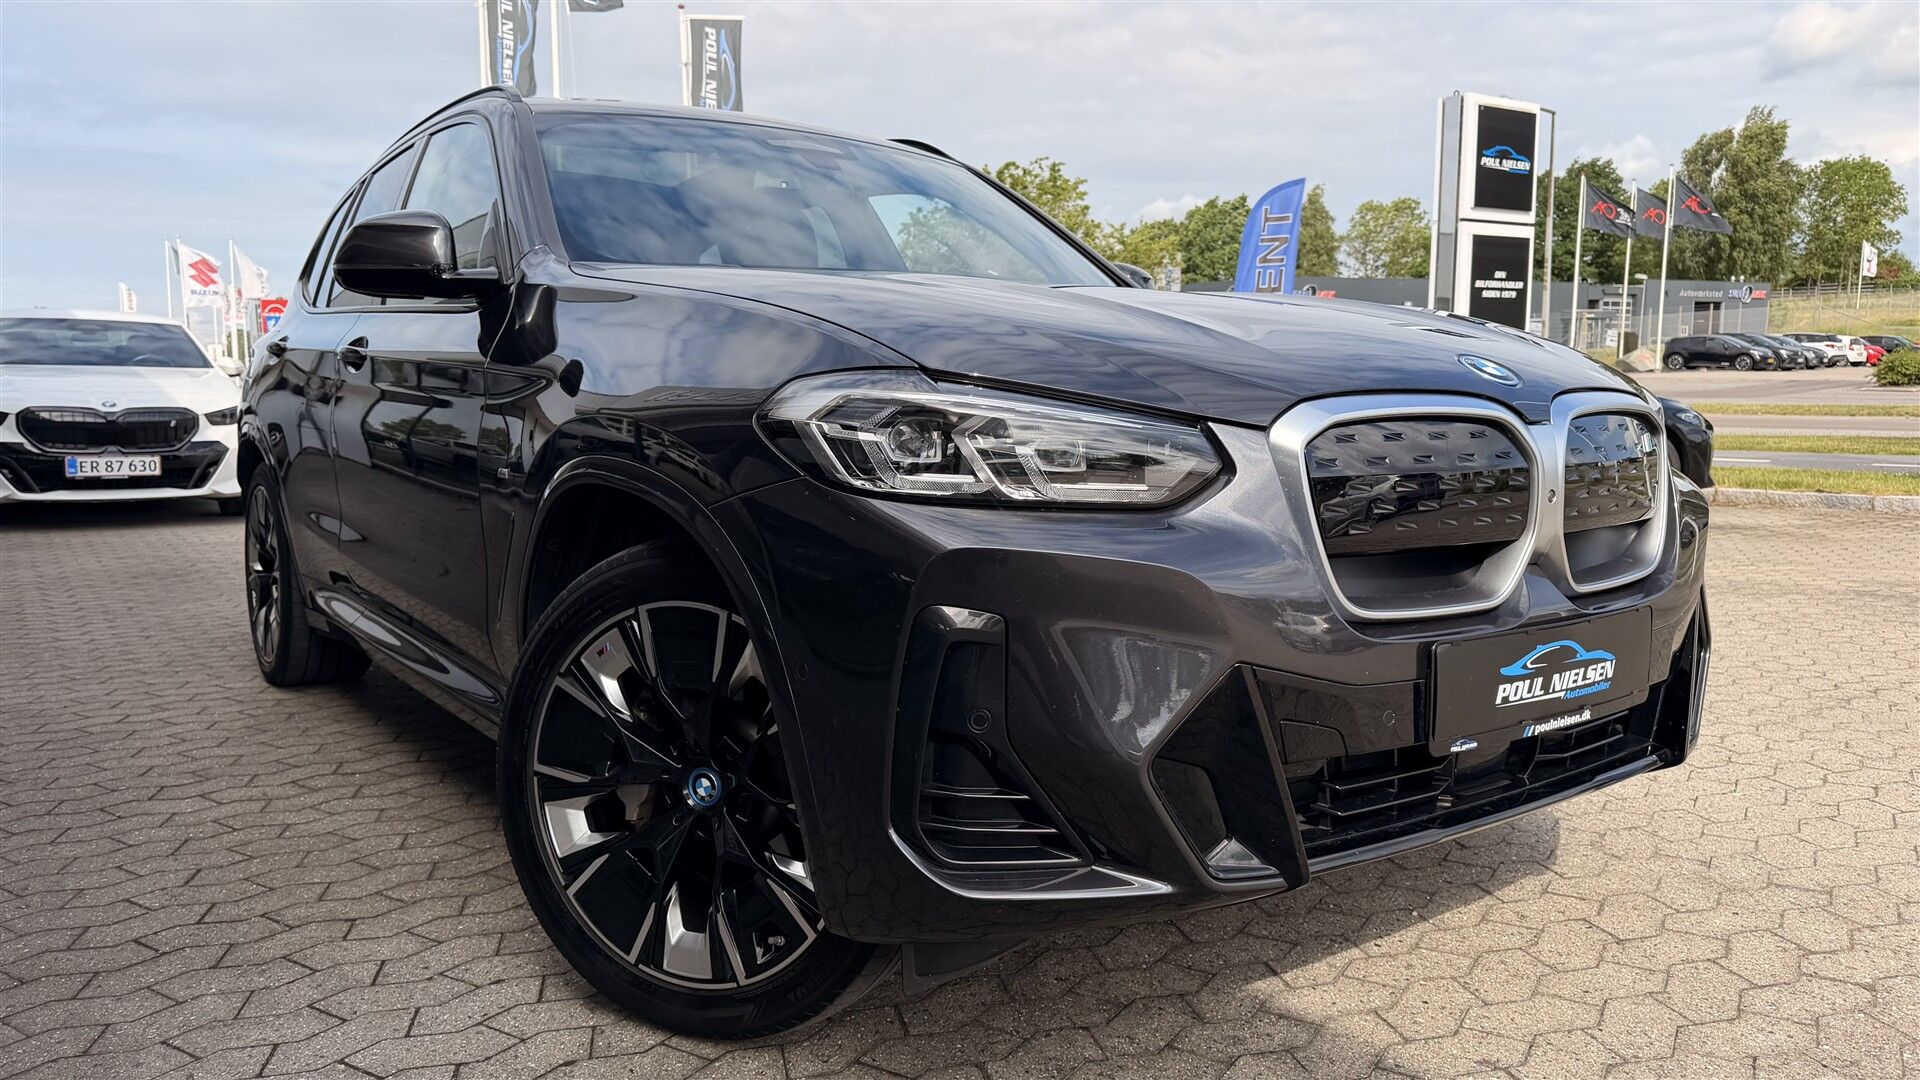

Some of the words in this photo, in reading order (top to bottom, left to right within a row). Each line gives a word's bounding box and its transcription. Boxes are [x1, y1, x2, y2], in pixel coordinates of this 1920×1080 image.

[704, 26, 718, 75] POUL
[1481, 156, 1501, 167] POUL
[1502, 159, 1531, 170] NIELSEN
[1254, 206, 1292, 294] ENT
[80, 460, 100, 474] ER
[104, 460, 124, 473] 87
[128, 459, 158, 473] 630
[1495, 676, 1545, 705] POUL
[1549, 659, 1616, 693] NIELSEN
[1563, 681, 1612, 700] Automobiler
